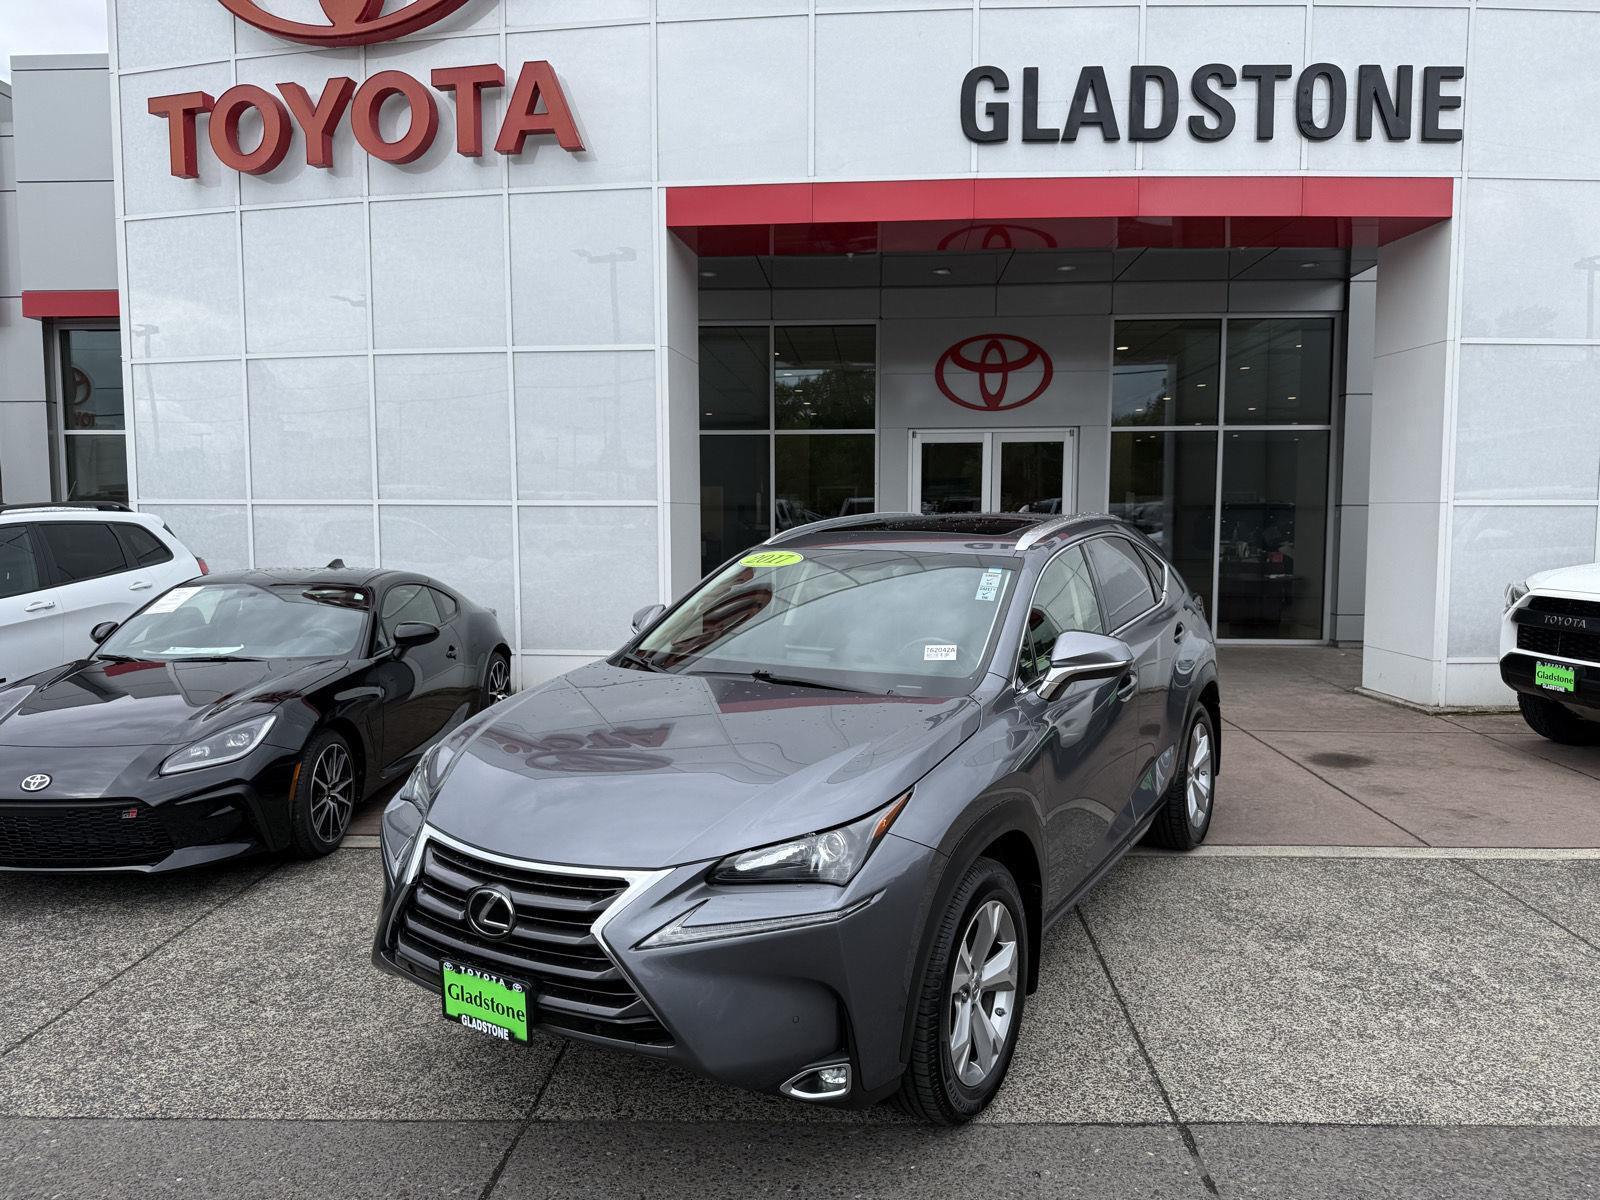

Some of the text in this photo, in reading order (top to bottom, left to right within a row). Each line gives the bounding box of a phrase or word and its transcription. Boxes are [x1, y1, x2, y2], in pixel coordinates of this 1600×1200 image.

[960, 63, 1465, 144] GLADSTONE
[148, 60, 586, 179] TOYOTA
[744, 554, 796, 564] 2017
[1544, 615, 1586, 629] TOYOTA
[1537, 670, 1573, 684] Gladstone
[459, 966, 505, 986] TOYOTA
[447, 983, 525, 1022] Gladstone
[461, 1015, 509, 1040] GLADSTONE
